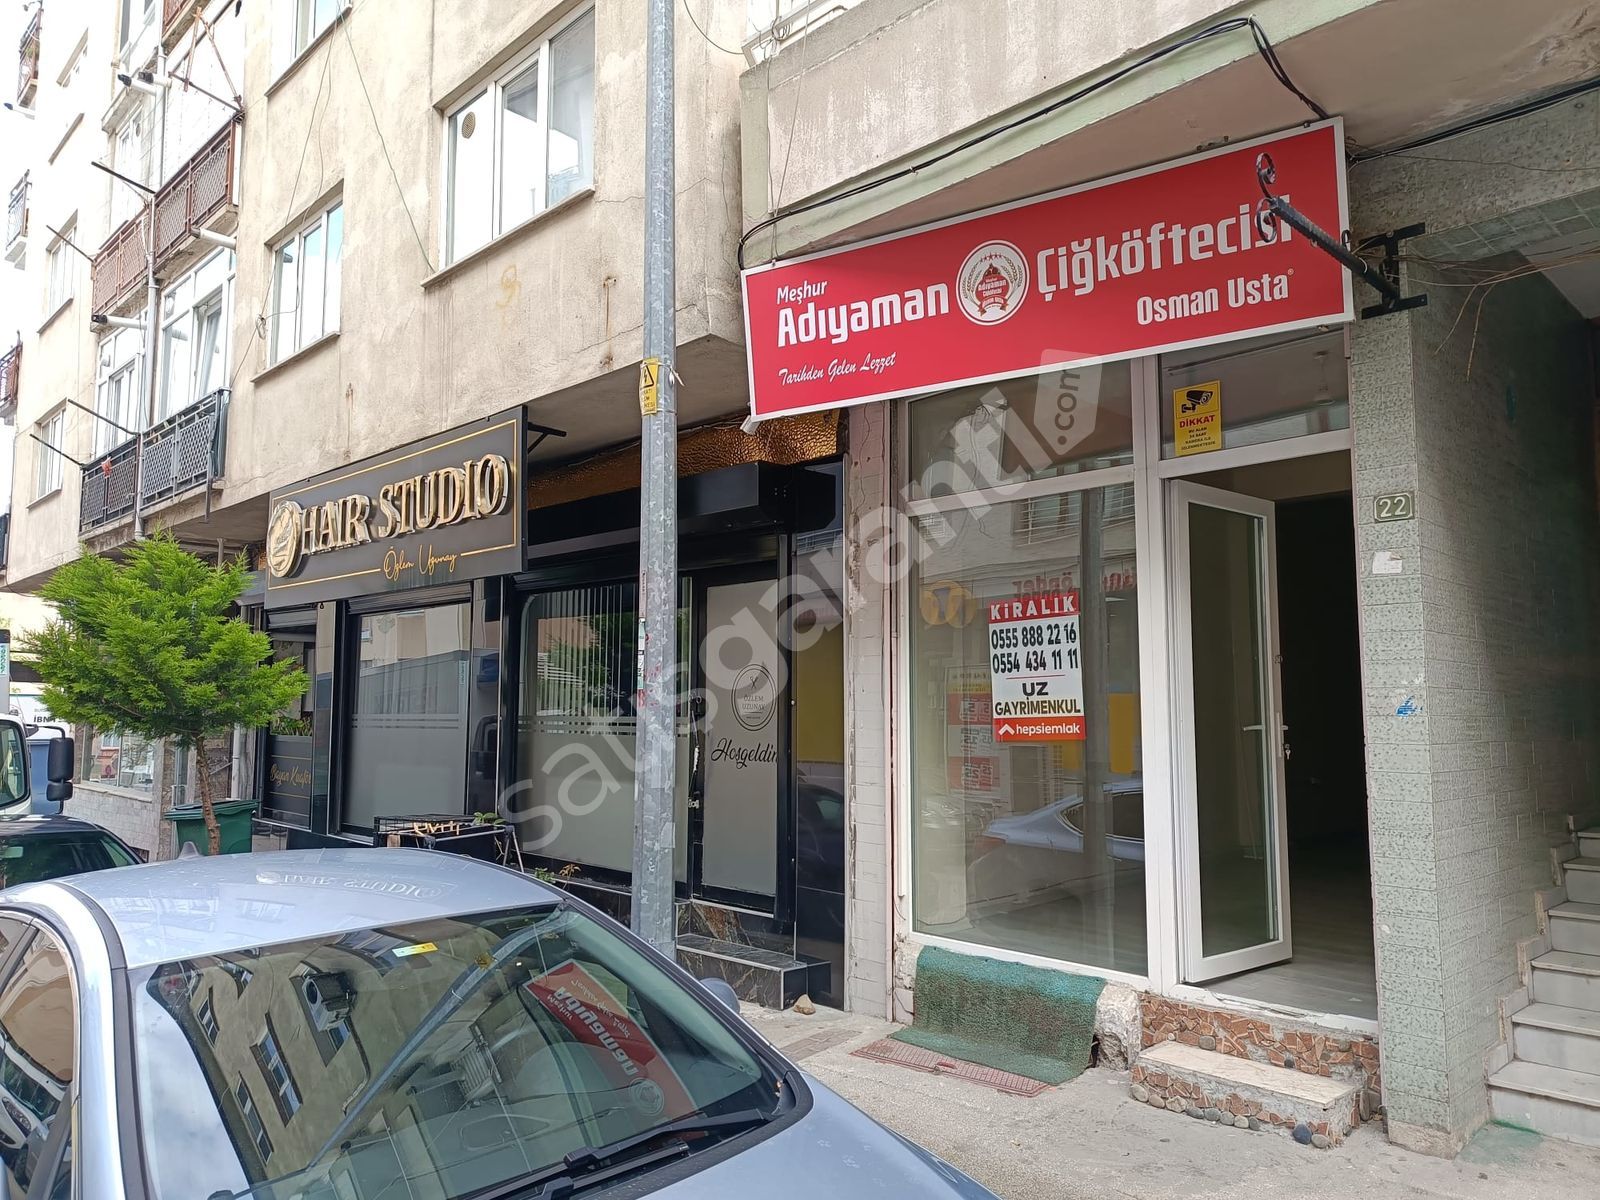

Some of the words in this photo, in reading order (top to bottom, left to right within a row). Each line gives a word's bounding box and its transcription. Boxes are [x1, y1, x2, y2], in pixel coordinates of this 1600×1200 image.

[777, 280, 828, 305] Meşhur
[1136, 288, 1219, 326] Osman
[1227, 273, 1289, 309] Usta
[777, 282, 949, 348] Adıyaman
[778, 367, 825, 387] Tarihden
[827, 359, 857, 383] Gelen
[860, 352, 897, 375] Lezzet
[1179, 414, 1215, 428] DİKKAT
[302, 494, 371, 555] HAIR
[378, 454, 509, 539] STUDIO
[1379, 496, 1406, 518] 22
[991, 627, 1018, 650] 0555
[1021, 625, 1044, 648] 888
[1046, 623, 1061, 645] 22
[1063, 621, 1077, 644] 16
[992, 652, 1020, 674] 0554
[1025, 650, 1047, 672] 434
[1051, 648, 1062, 670] 11
[1067, 647, 1079, 669] 11
[1022, 681, 1049, 697] UZ
[994, 696, 1081, 716] GAYRİMENKUL
[1016, 722, 1080, 737] hepsiemlak
